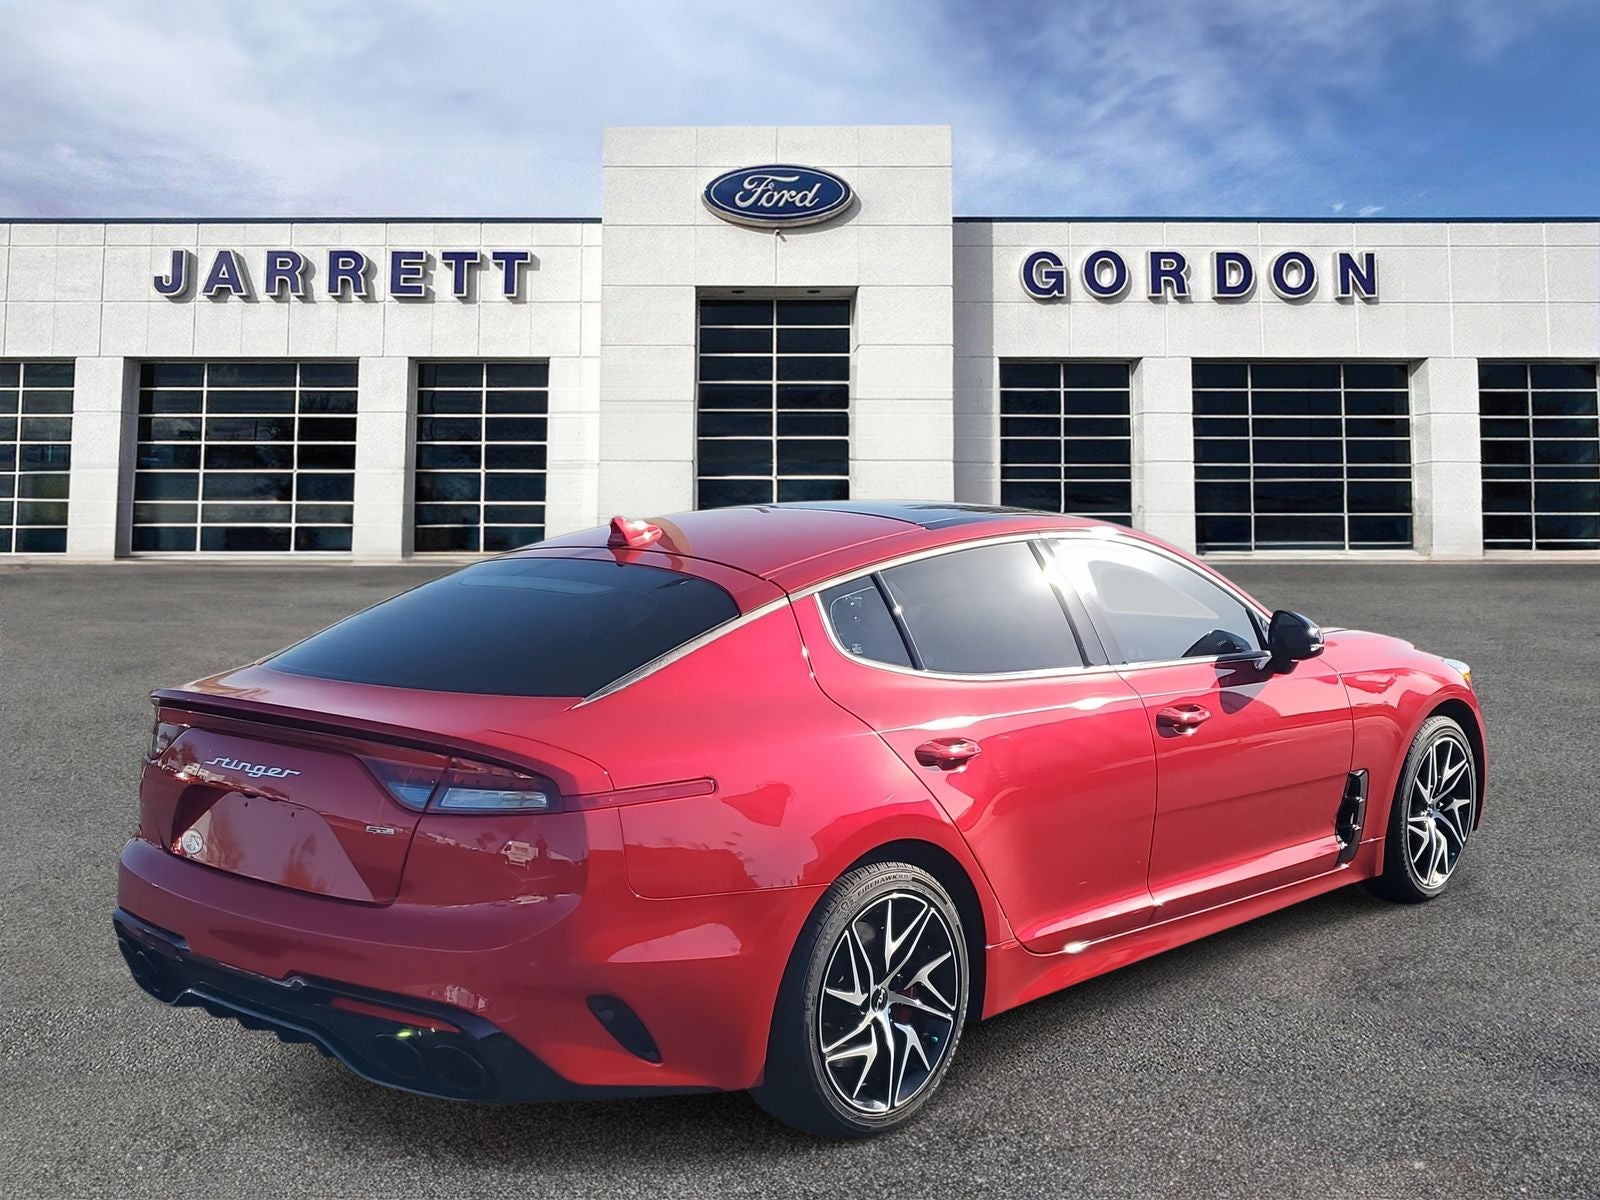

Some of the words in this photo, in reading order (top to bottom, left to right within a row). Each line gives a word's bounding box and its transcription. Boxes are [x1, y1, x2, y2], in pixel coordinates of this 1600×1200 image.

[735, 174, 822, 208] Ford
[153, 248, 532, 299] JARRETT
[1019, 249, 1379, 300] GORDON
[857, 873, 899, 897] FIREHAWK
